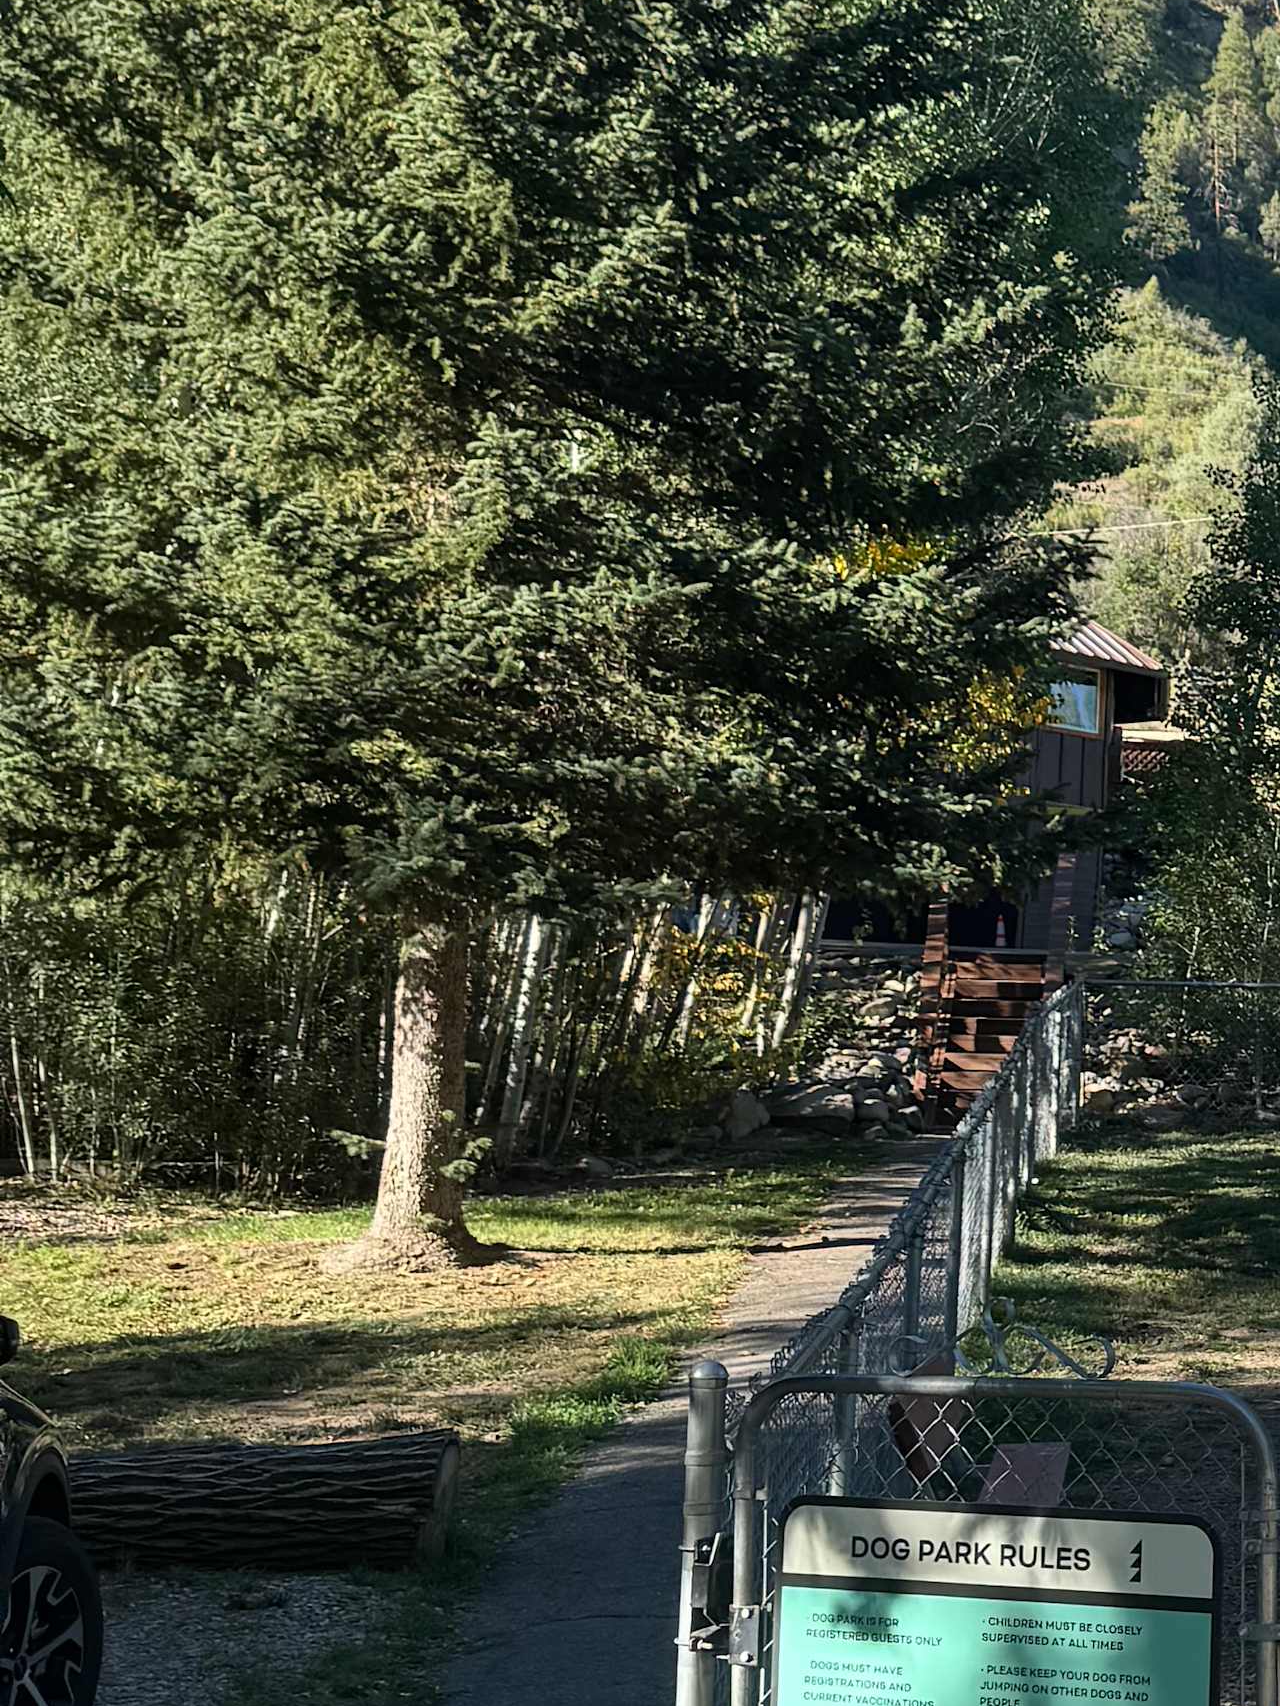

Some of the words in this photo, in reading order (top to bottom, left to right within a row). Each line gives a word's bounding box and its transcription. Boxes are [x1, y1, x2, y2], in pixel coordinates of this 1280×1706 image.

[851, 1536, 910, 1560] DOG
[919, 1540, 991, 1565] PARK
[1000, 1544, 1091, 1571] RULES
[813, 1613, 834, 1623] DOG
[837, 1614, 863, 1625] PARK
[866, 1617, 876, 1626] IS
[879, 1617, 899, 1626] FOR
[989, 1617, 1042, 1629] CHILDREN
[1046, 1621, 1076, 1632] MUST
[1079, 1623, 1092, 1632] BE
[1095, 1624, 1142, 1636] CLOSELY
[807, 1629, 868, 1641] REGISTERED
[871, 1632, 912, 1644] GUESTS
[915, 1636, 942, 1646] ONLY
[982, 1633, 1048, 1645] SUPERVISED
[1052, 1637, 1065, 1646] AT
[1069, 1639, 1088, 1648] ALL
[1091, 1640, 1123, 1651] TIMES
[810, 1660, 839, 1670] DOGS
[842, 1663, 871, 1672] MUST
[874, 1666, 903, 1675] HAVE
[987, 1665, 1027, 1676] PLEASE
[1029, 1668, 1057, 1678] KEEP
[1060, 1670, 1089, 1681] YOUR
[1093, 1673, 1116, 1683] DOG
[1120, 1675, 1150, 1685] FROM
[805, 1676, 885, 1690] REGISTRATIONS
[889, 1682, 911, 1692] AND
[980, 1681, 1029, 1692] JUMPING
[1032, 1684, 1048, 1693] ON
[1051, 1686, 1088, 1697] OTHER
[1091, 1689, 1122, 1699] DOGS
[1125, 1691, 1148, 1702] AND
[804, 1692, 852, 1703] CURRENT
